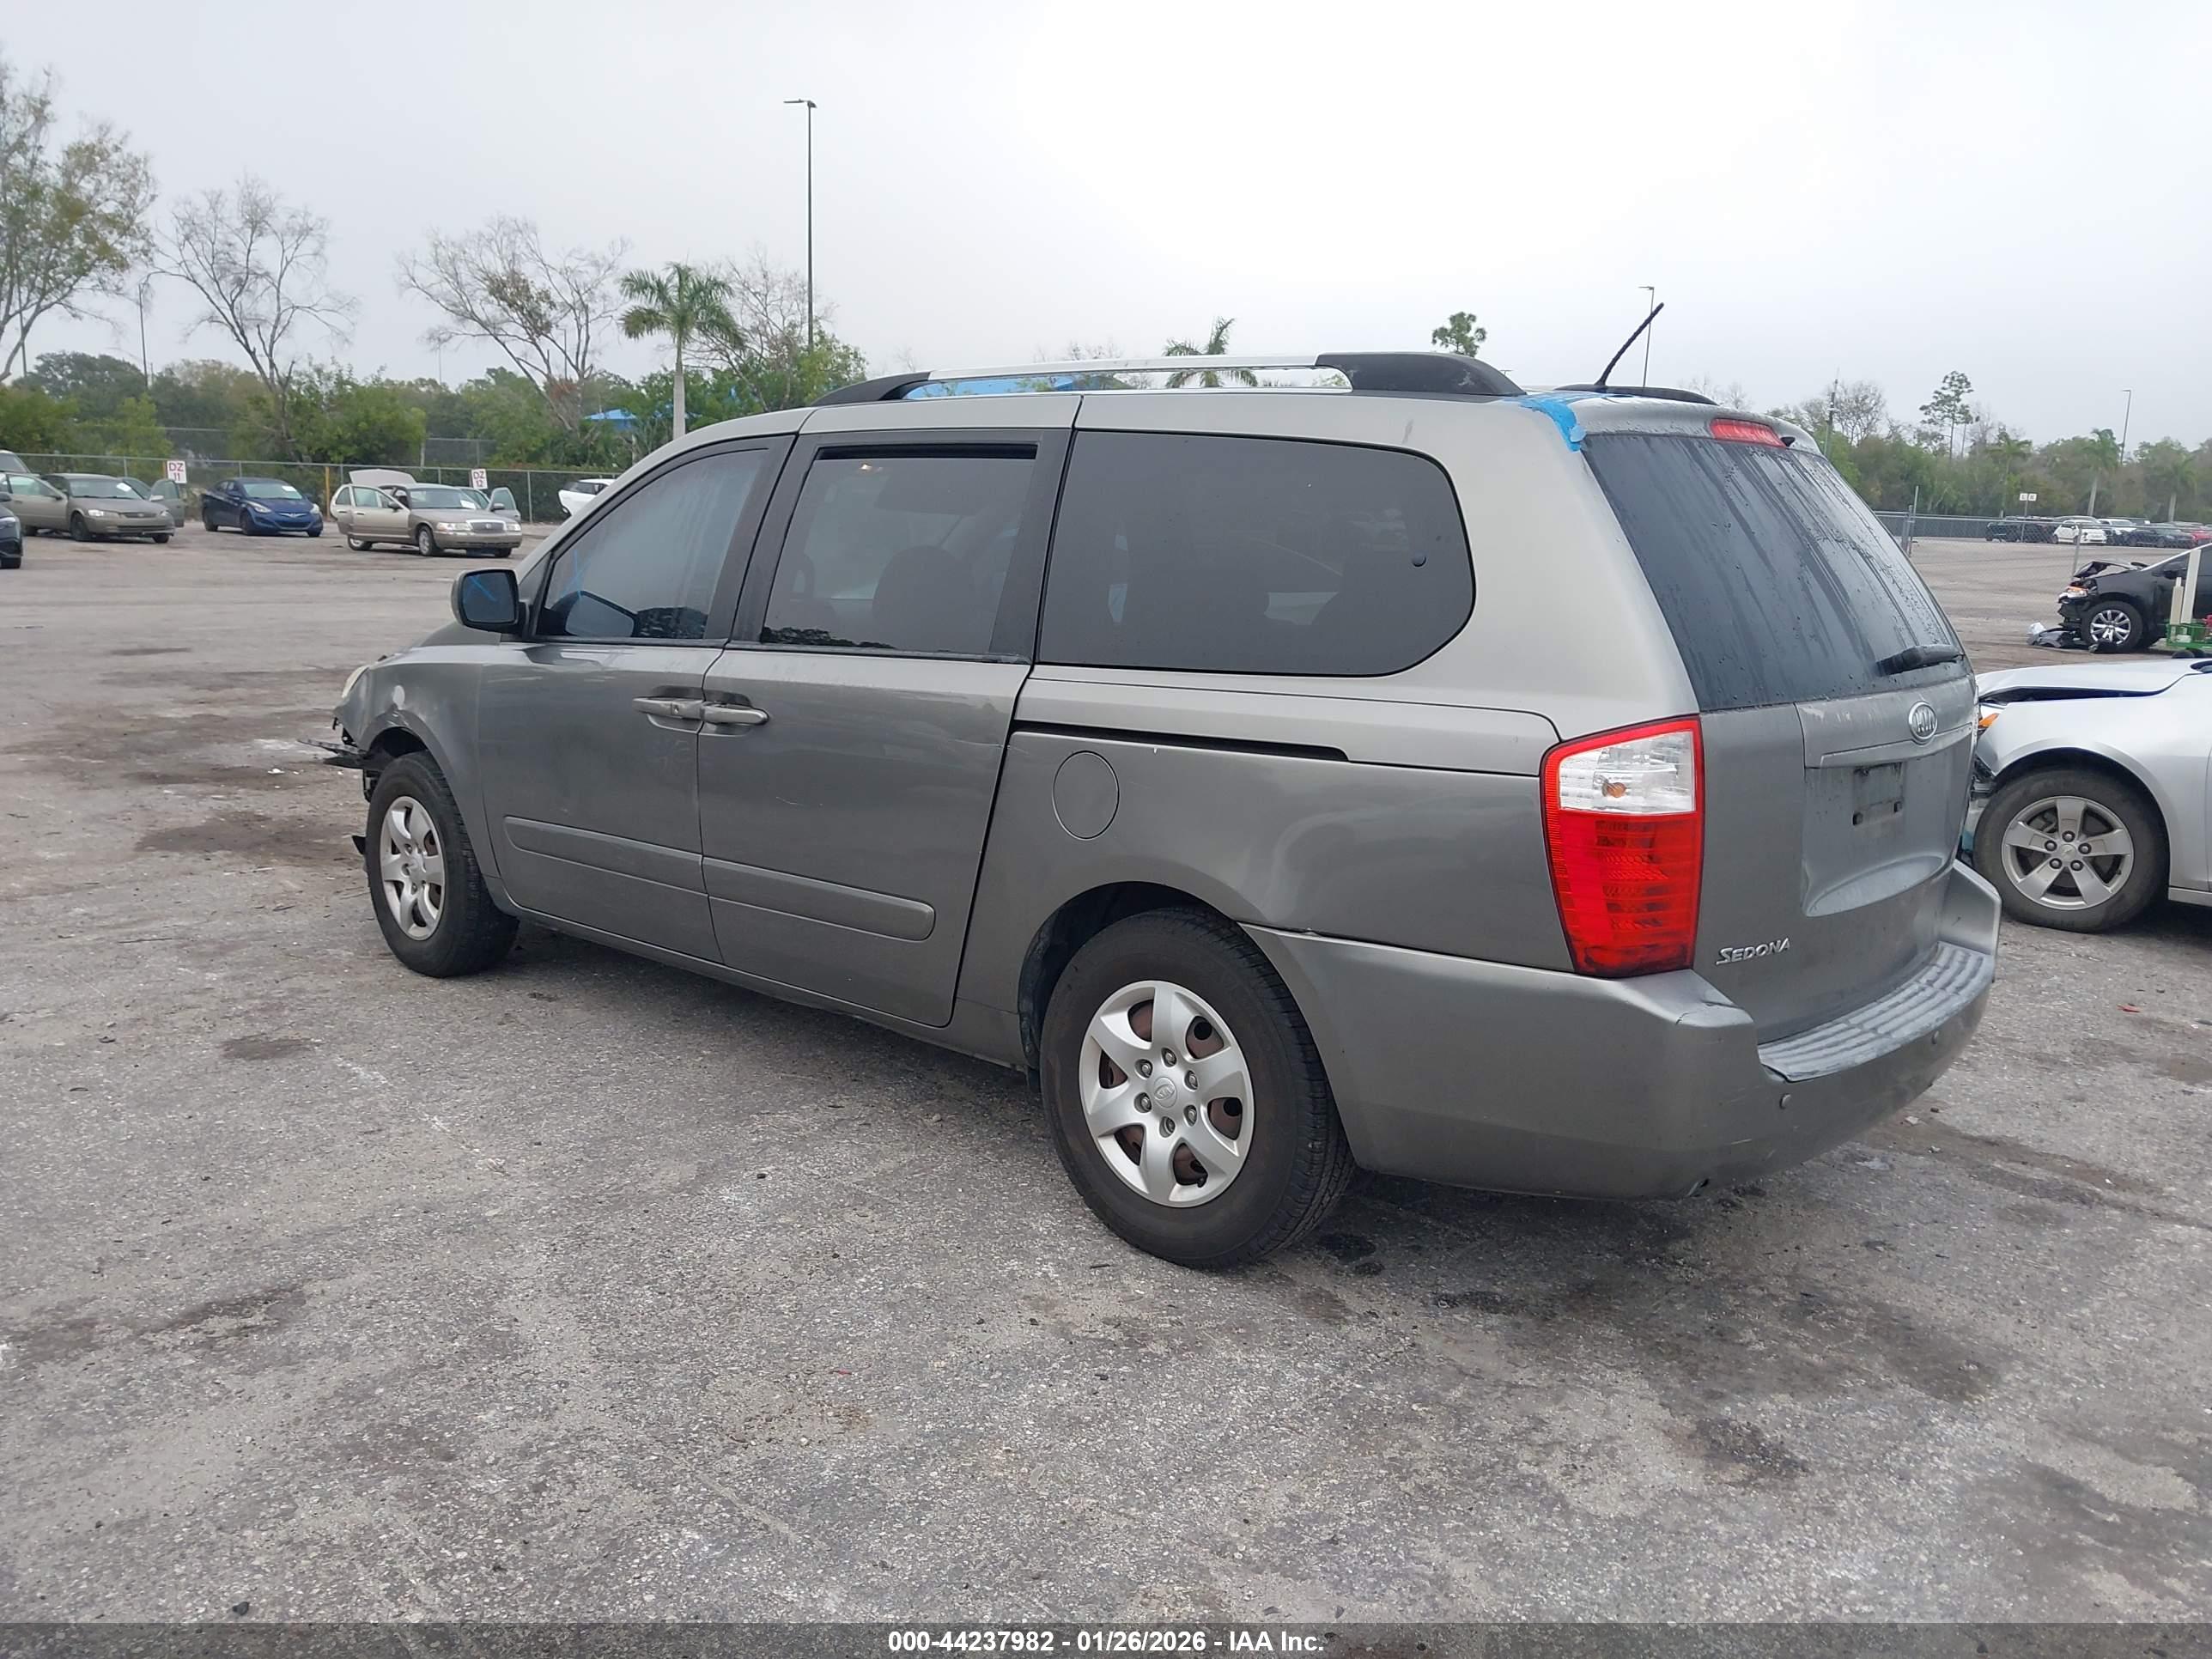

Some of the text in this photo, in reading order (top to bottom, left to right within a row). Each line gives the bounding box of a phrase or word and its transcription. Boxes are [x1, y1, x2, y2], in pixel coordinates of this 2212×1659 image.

[169, 462, 184, 471] DZ
[173, 472, 180, 481] 11
[473, 471, 485, 479] DZ
[1716, 938, 1790, 965] SEDONA
